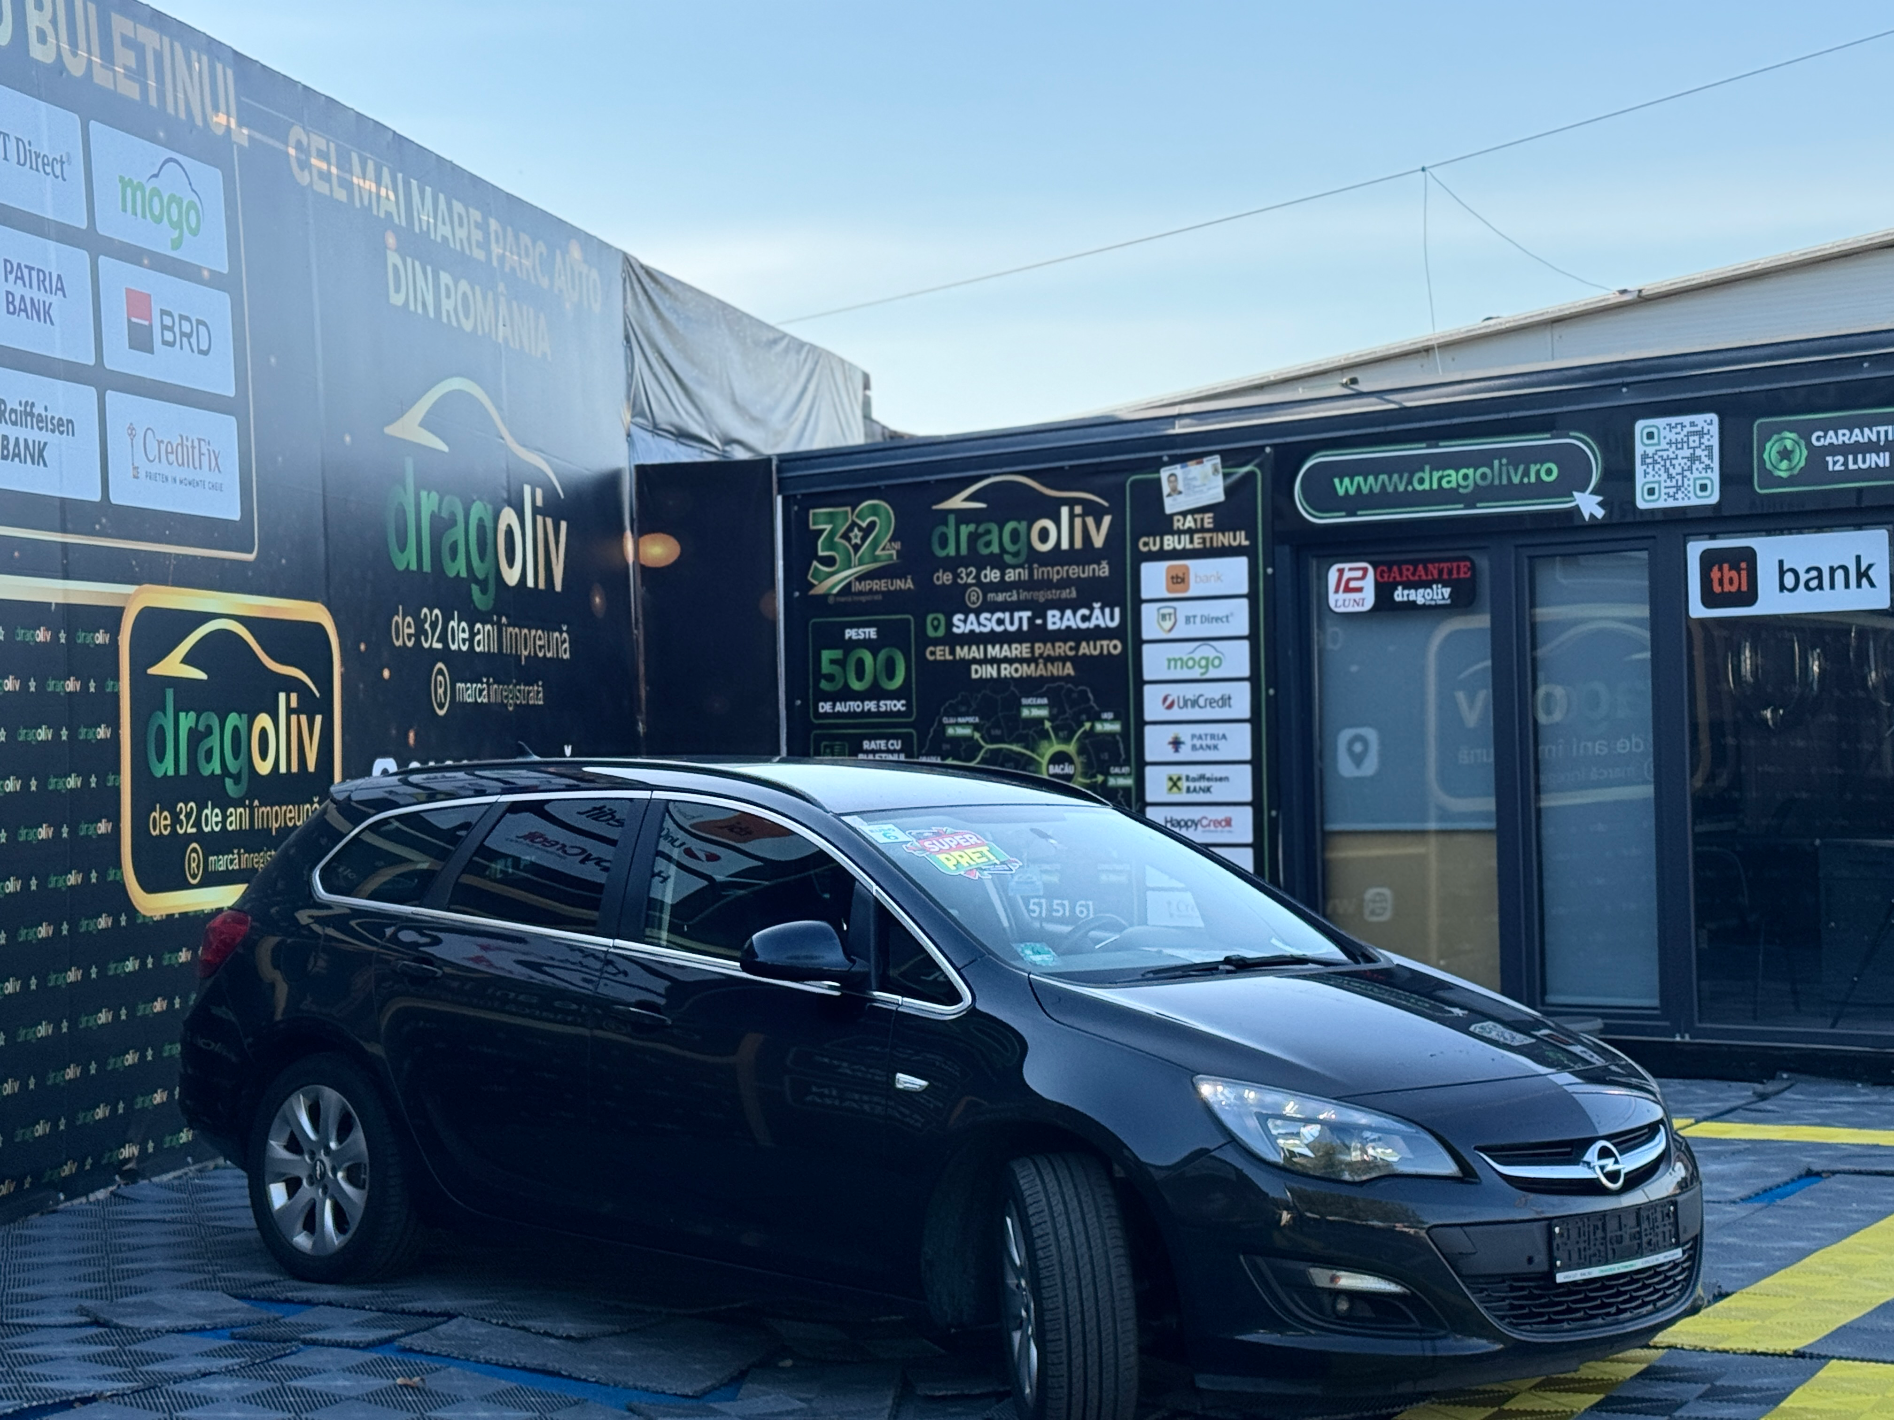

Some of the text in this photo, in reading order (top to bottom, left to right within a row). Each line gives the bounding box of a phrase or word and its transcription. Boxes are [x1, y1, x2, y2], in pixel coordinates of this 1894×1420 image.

[26, 0, 248, 147] BULETINUL
[118, 175, 201, 251] mogo
[287, 124, 600, 313] CEL MAI MARE PARC AUTO
[3, 258, 67, 299] PATRIA
[5, 290, 54, 326] BANK
[387, 249, 551, 362] DIN ROMÂNIA
[160, 308, 212, 357] BRD
[0, 399, 75, 437] Raiffeisen
[1811, 425, 1894, 446] GARANȚI
[0, 433, 48, 468] BANK
[143, 426, 222, 474] CreditFix
[1826, 452, 1890, 471] 12 LUNI
[145, 471, 169, 484] PRIETEN
[1334, 458, 1558, 496] www.dragoliv.ro
[1173, 513, 1214, 530] RATE
[387, 456, 567, 611] dragoliv
[807, 500, 896, 586] 32
[931, 505, 1112, 565] dragoliv
[1138, 531, 1249, 552] CU BULETINUL
[933, 561, 1110, 585] de 32 de ani împreună
[1170, 571, 1223, 585] tbi bank
[1333, 566, 1369, 595] 12
[1376, 561, 1471, 583] GARANTIE
[1710, 554, 1877, 594] tbi bank
[851, 576, 914, 592] ÎMPREUNĂ
[987, 590, 1018, 602] marcă
[1019, 587, 1077, 602] înregistrată
[1394, 584, 1451, 605] dragoliv
[1334, 598, 1366, 609] LUNI
[952, 611, 1032, 634] SASCUT
[1046, 602, 1120, 630] BACĂU
[1161, 612, 1173, 622] BT
[1185, 615, 1198, 625] BT
[391, 605, 570, 665] de 32 de ani împreună
[845, 628, 877, 640] PESTE
[925, 639, 1122, 661] CEL MAI MARE PARC AUTO
[820, 647, 906, 692] 500
[970, 659, 1075, 679] DIN ROMÂNIA
[1167, 655, 1223, 676] mogo
[456, 677, 488, 704] marcă
[489, 678, 544, 711] înregistrată
[1177, 694, 1232, 710] UniCredit
[818, 700, 907, 713] DE AUTO PE STOC
[147, 688, 322, 798] dragoliv
[862, 740, 901, 750] RATE CU
[1191, 733, 1228, 742] PATRIA
[1191, 744, 1220, 752] BANK
[1048, 763, 1075, 775] BACĂU
[1185, 773, 1229, 783] Raiffeisen
[1185, 786, 1212, 794] BANK
[149, 803, 171, 836] de
[176, 802, 197, 834] 32
[201, 801, 222, 832] de
[226, 800, 249, 831] ani
[1165, 816, 1233, 832] HappyCredit
[923, 833, 981, 852] SUPER
[208, 849, 239, 872] marcă
[1029, 898, 1094, 918] 51 51 61
